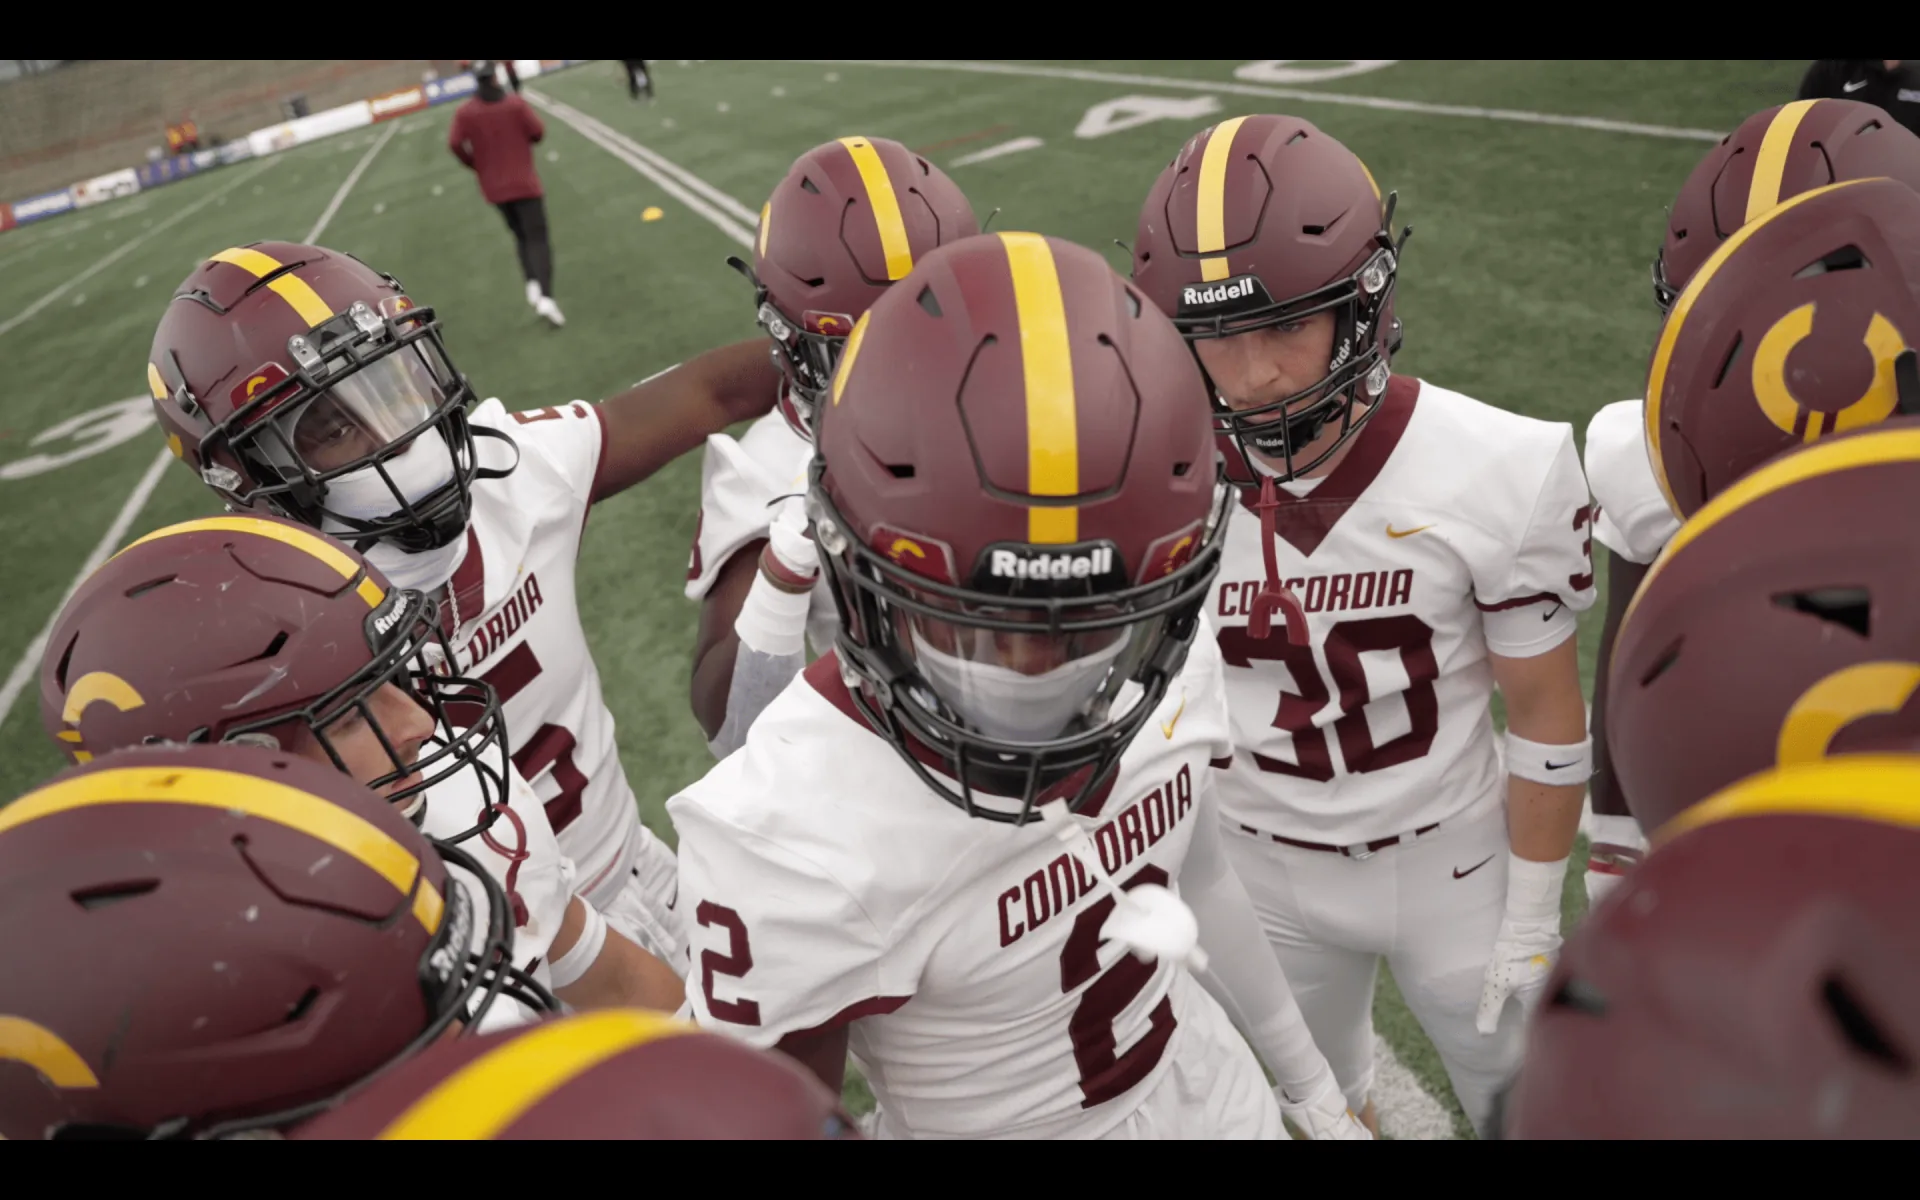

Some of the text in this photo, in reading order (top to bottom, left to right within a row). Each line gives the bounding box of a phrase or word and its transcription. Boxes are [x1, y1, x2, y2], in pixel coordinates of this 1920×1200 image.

[1184, 277, 1254, 305] Riddell
[1255, 437, 1285, 447] Ridde
[991, 547, 1112, 580] Riddell
[1216, 613, 1440, 784] 30
[695, 898, 762, 1027] 2
[1060, 862, 1178, 1111] 2
